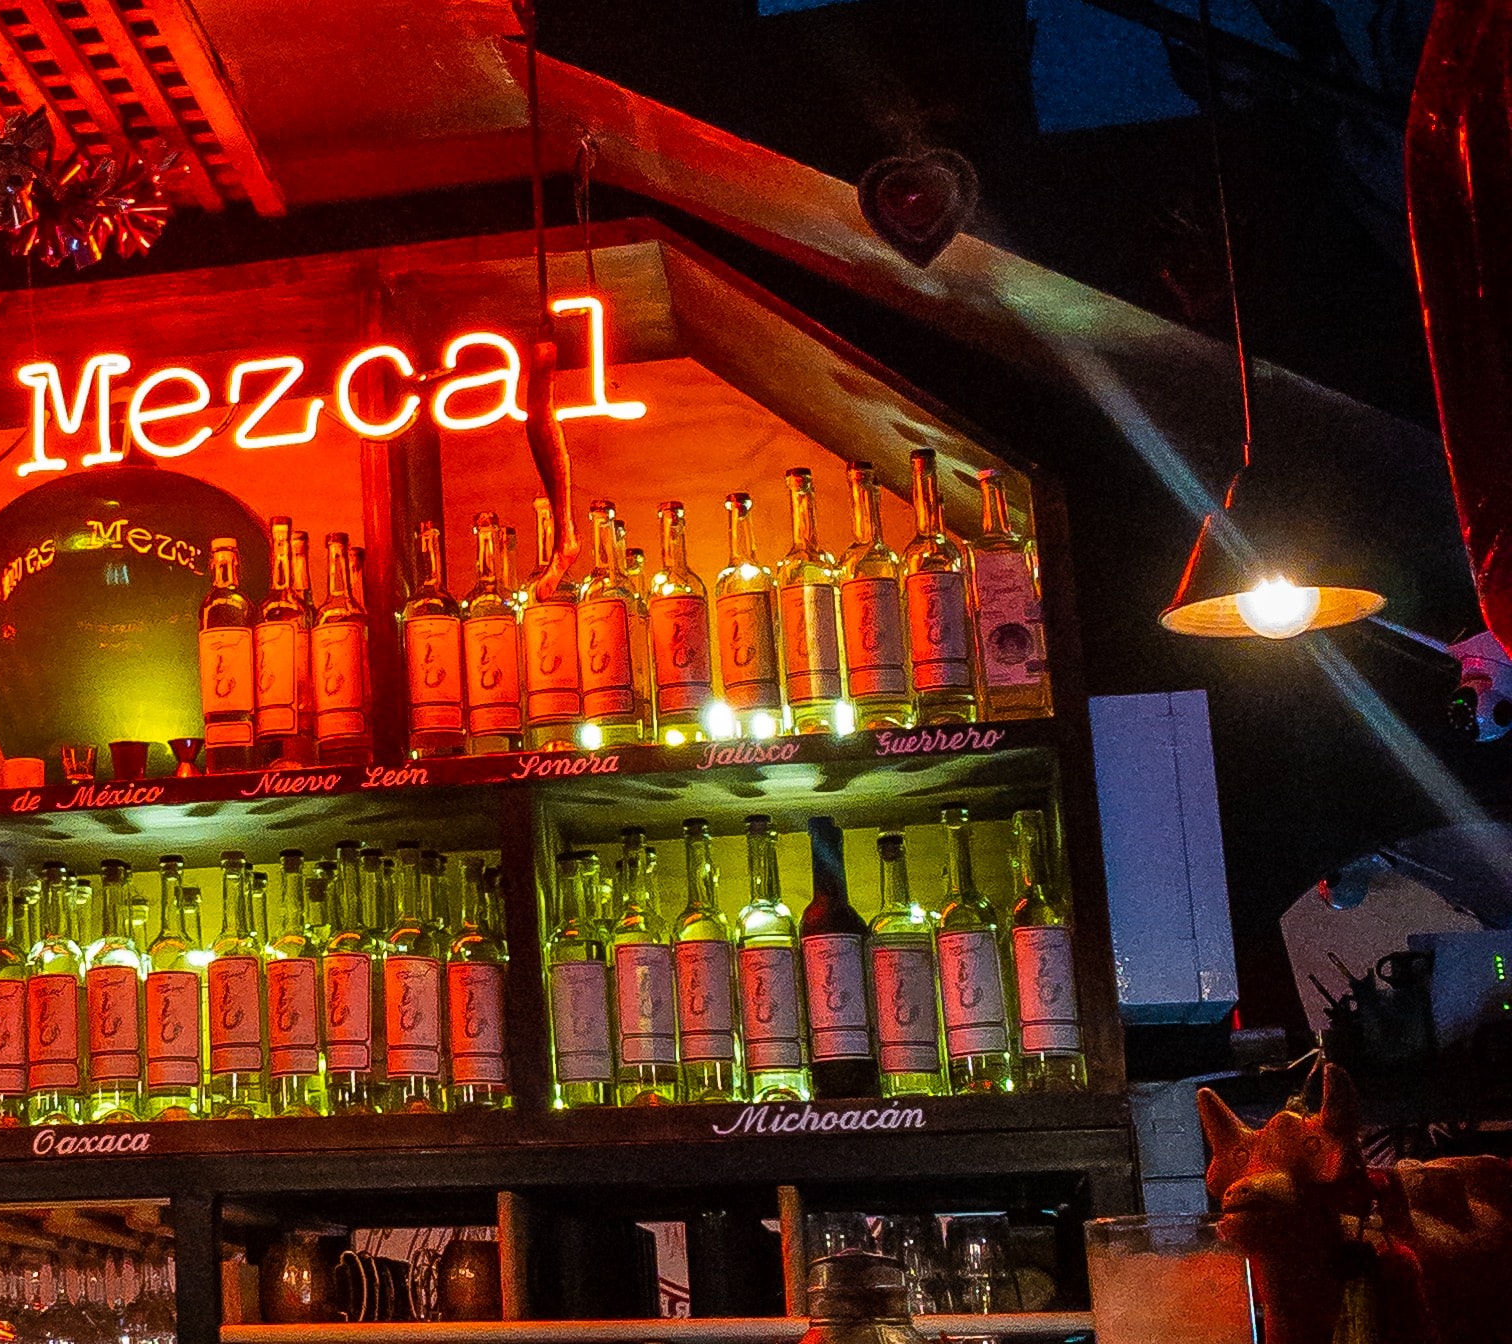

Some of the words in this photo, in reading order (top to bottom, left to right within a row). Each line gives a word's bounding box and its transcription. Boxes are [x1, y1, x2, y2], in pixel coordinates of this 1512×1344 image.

[16, 296, 648, 478] Mezcal
[695, 740, 800, 771] Jalisco
[875, 726, 1006, 757] Guerrero
[241, 771, 341, 796] Nuevo
[361, 764, 428, 788] León
[511, 753, 620, 780] Sonora
[11, 788, 42, 811] de
[56, 781, 164, 810] México
[712, 1100, 926, 1136] Michoacán
[32, 1128, 151, 1154] Oaxaca
